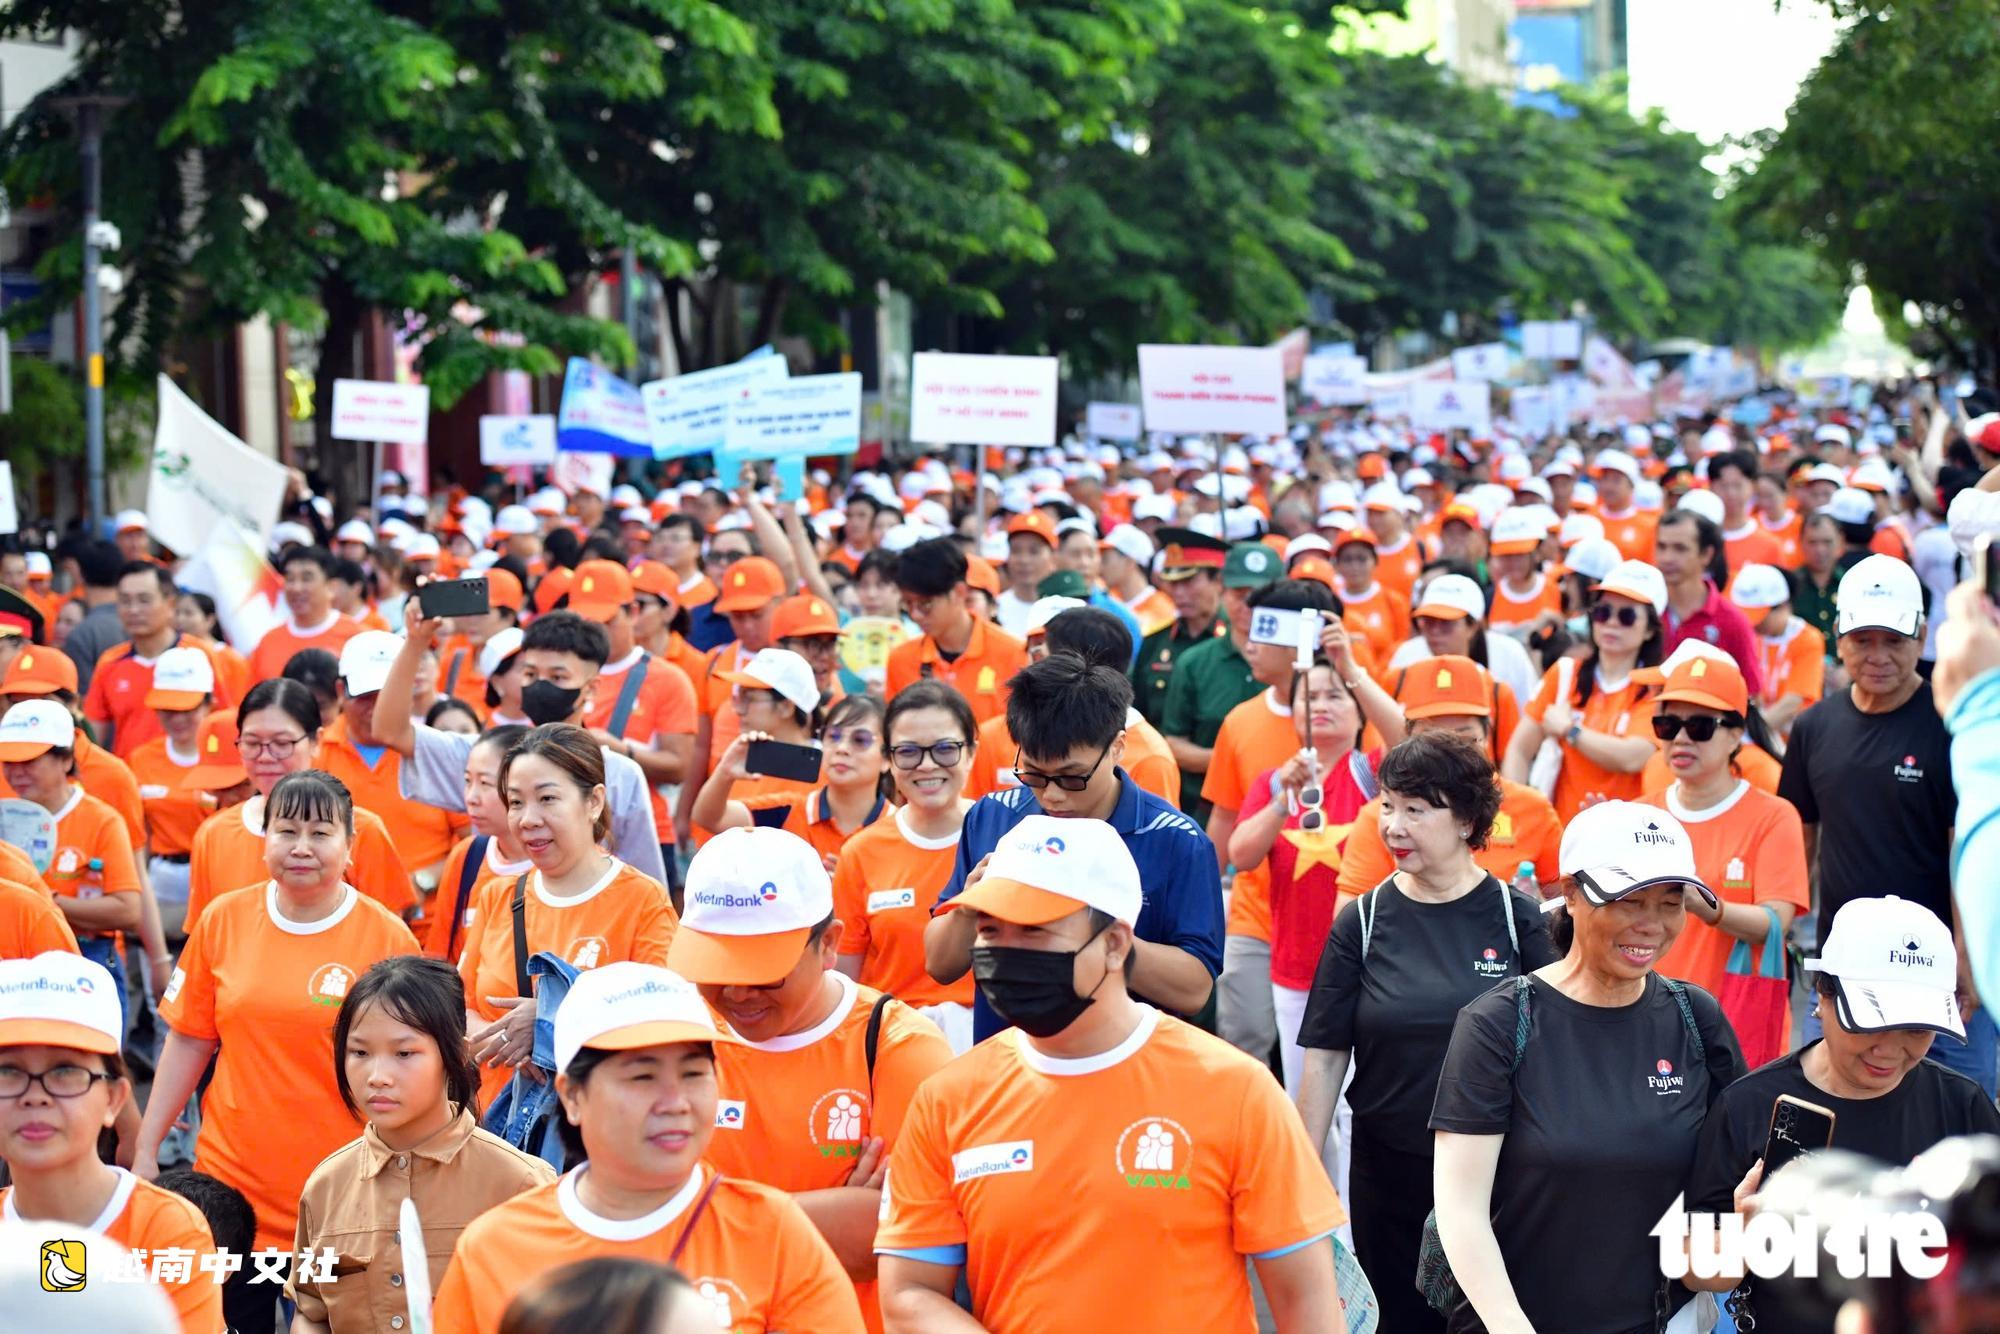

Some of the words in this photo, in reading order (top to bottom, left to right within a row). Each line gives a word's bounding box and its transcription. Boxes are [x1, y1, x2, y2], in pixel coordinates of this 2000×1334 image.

[1634, 832, 1675, 845] Fujiwa
[694, 892, 762, 907] VietinBank
[1890, 950, 1933, 967] Fujiwa
[1474, 960, 1508, 973] Fujiwa
[1126, 1174, 1192, 1189] VAVA
